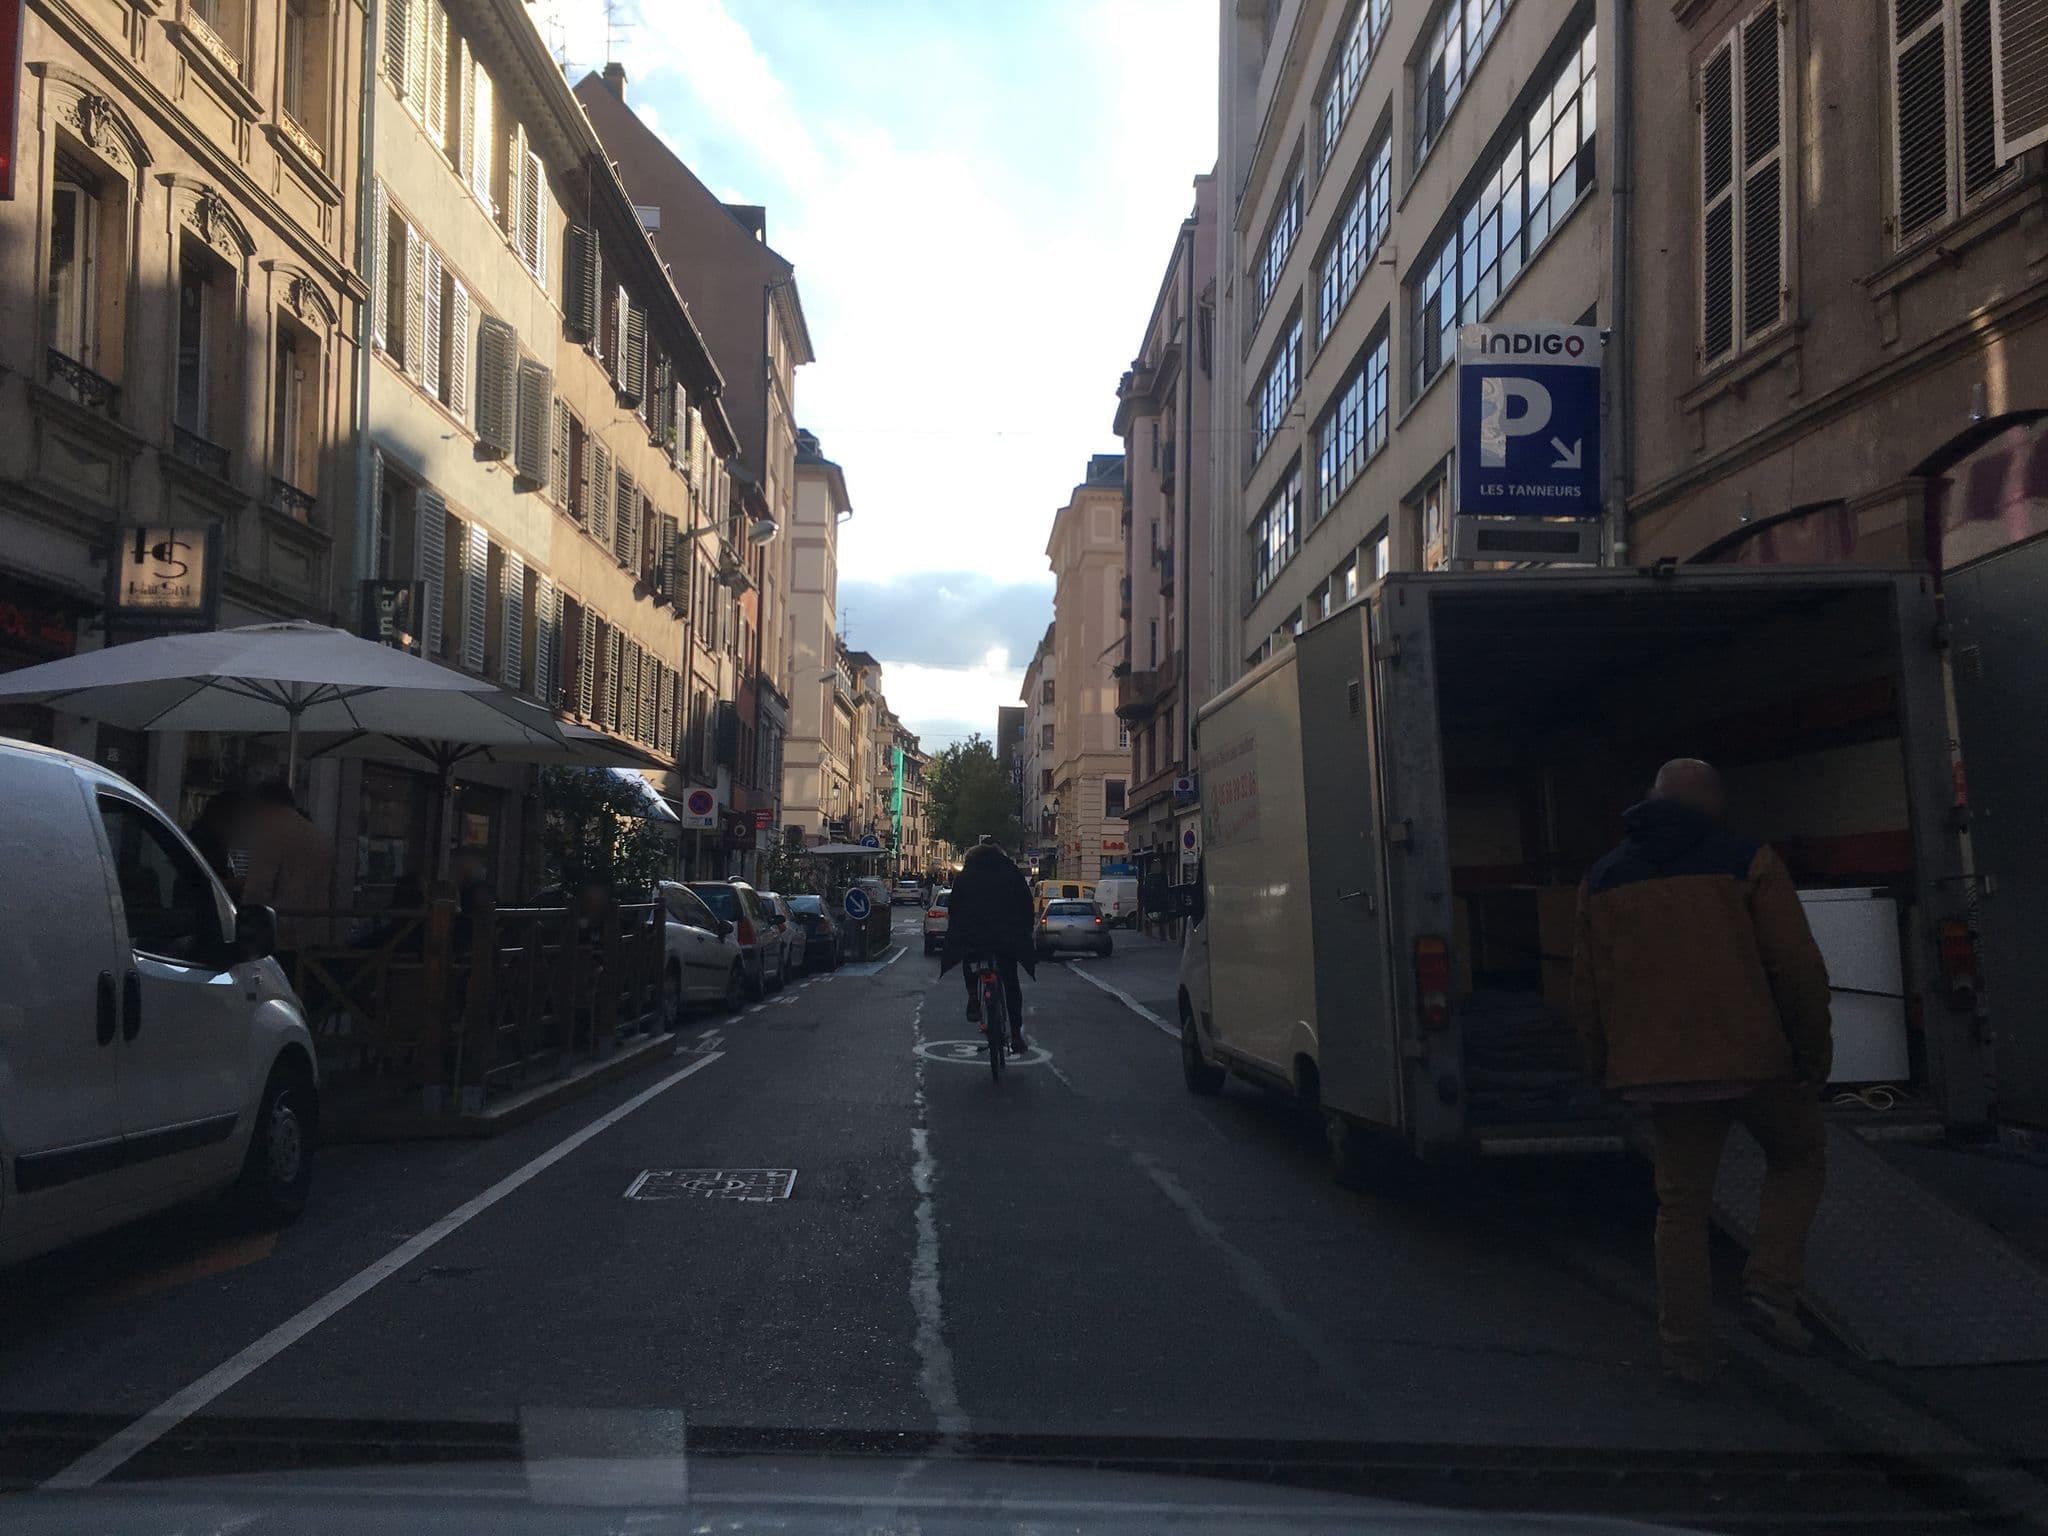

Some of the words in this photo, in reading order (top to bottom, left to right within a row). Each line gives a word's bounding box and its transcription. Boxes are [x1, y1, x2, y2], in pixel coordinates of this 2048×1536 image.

[1480, 333, 1585, 358] INDIGO
[1480, 376, 1553, 468] P
[1480, 484, 1504, 497] LES
[1508, 484, 1582, 498] TANNEURS
